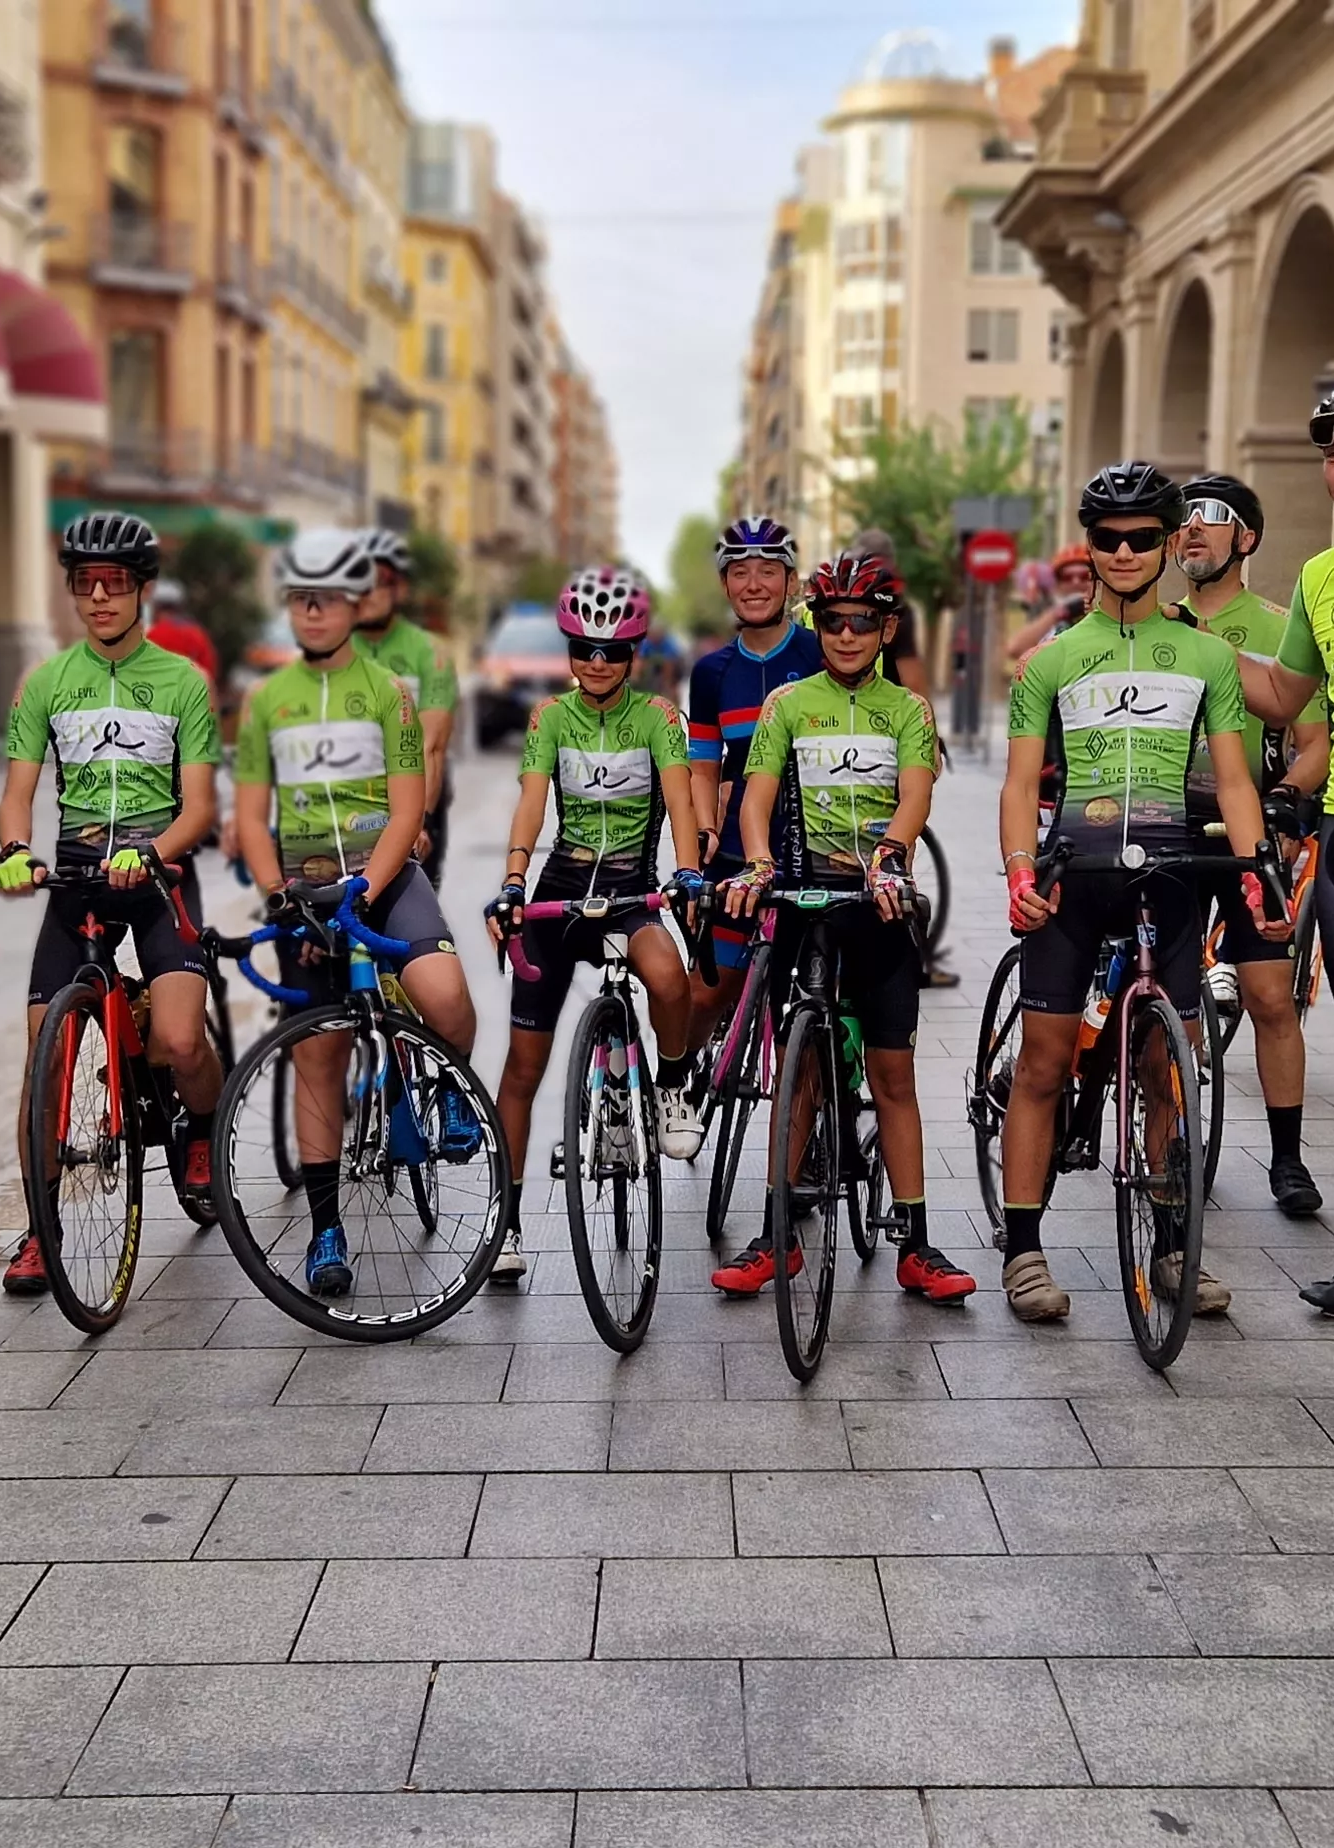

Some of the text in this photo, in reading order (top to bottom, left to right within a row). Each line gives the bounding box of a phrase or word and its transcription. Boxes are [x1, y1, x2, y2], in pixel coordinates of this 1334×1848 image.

[821, 716, 839, 728] ulb
[1103, 767, 1158, 775] CICLOS
[395, 1030, 497, 1154] FORZA
[328, 1273, 468, 1325] FORZA
